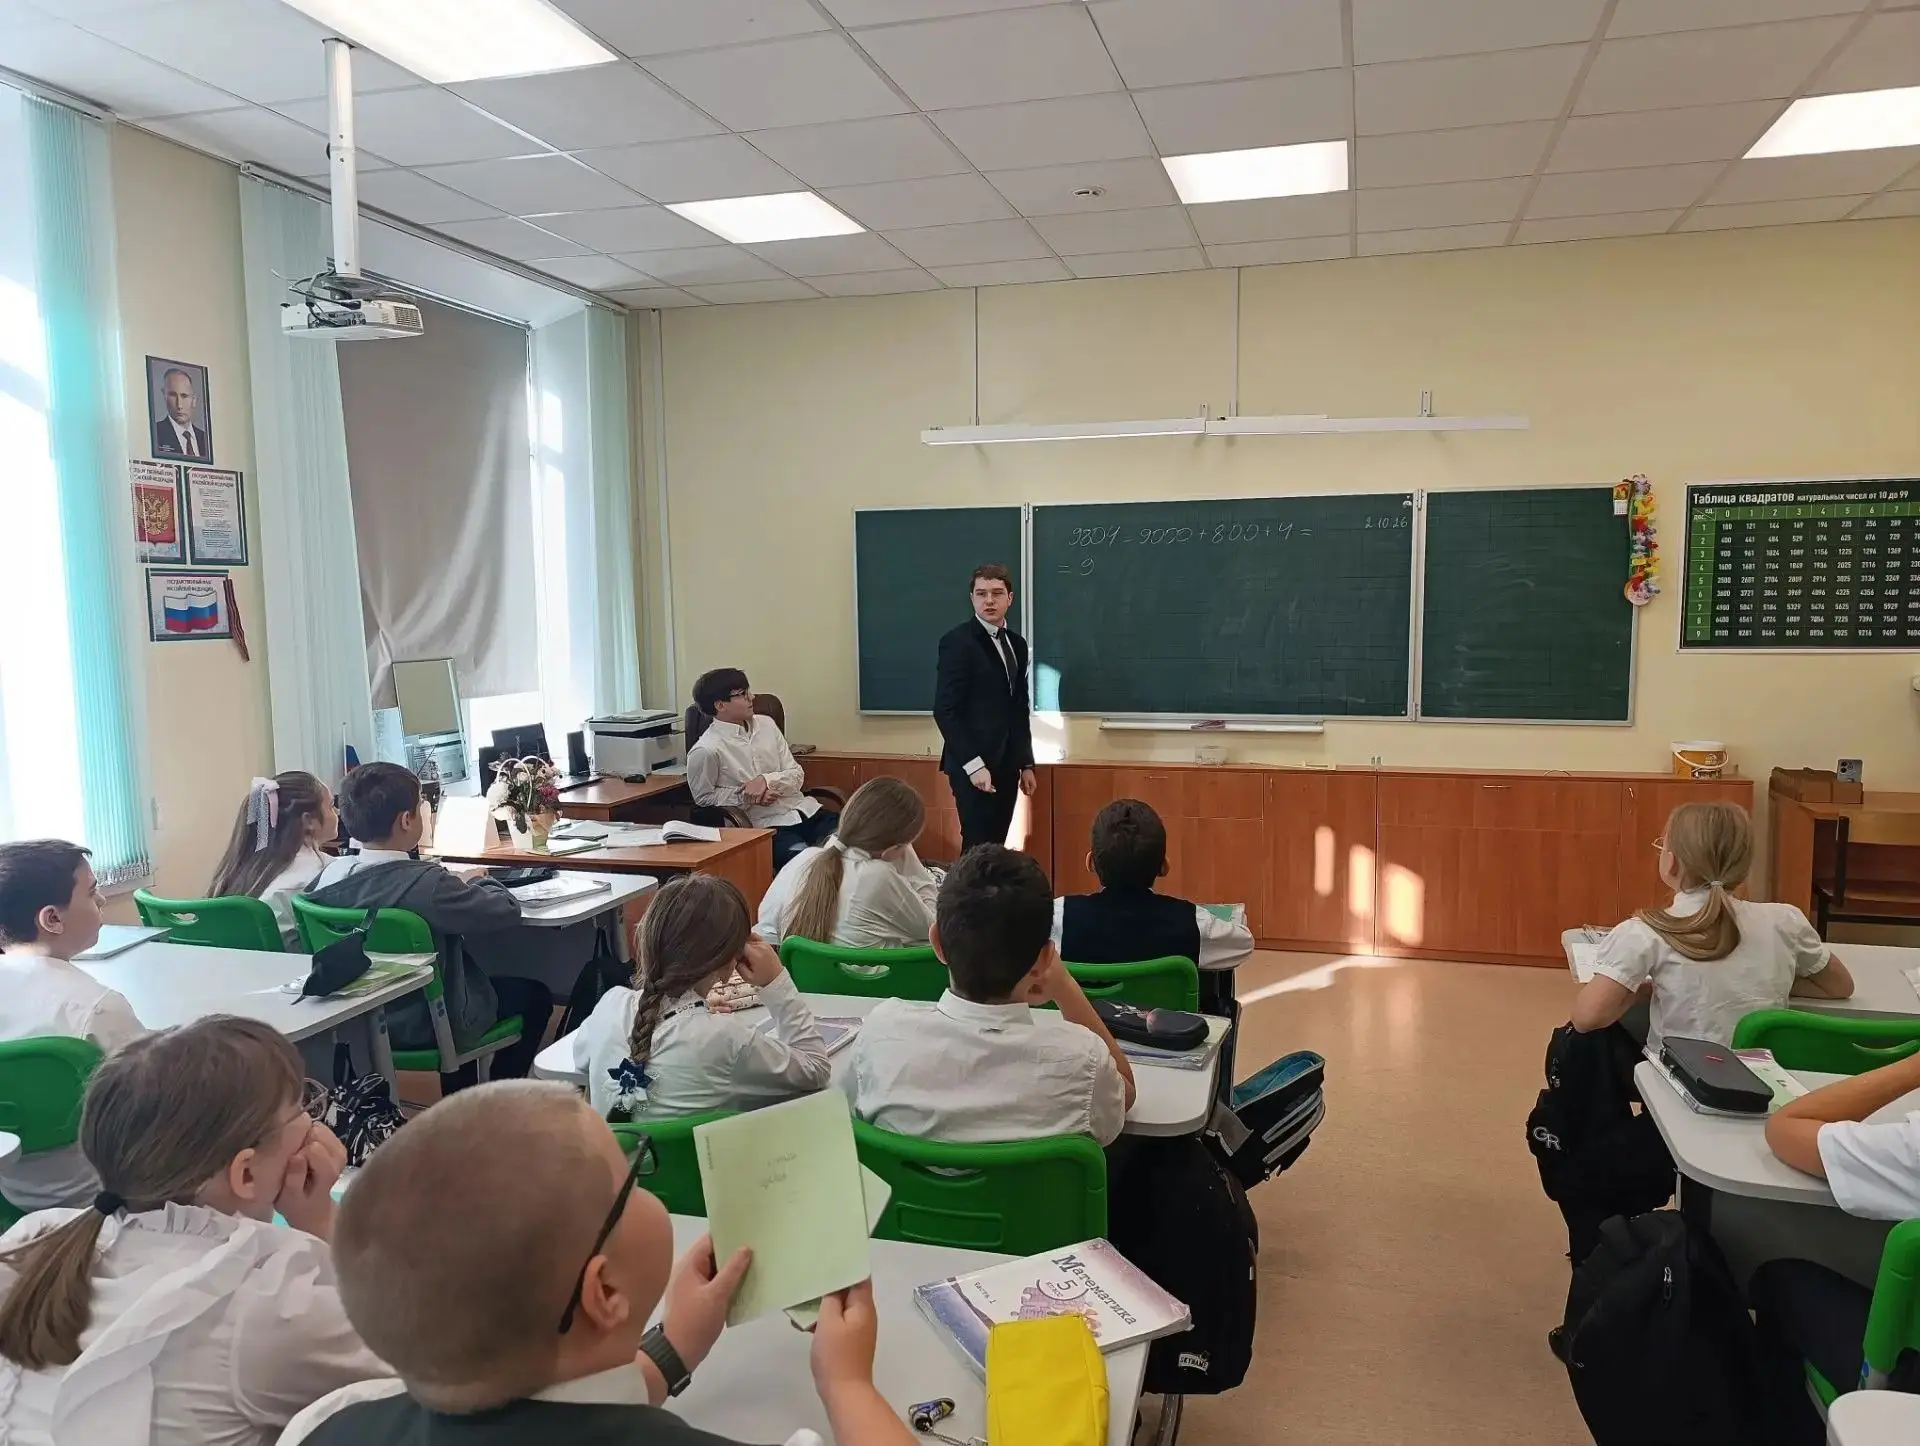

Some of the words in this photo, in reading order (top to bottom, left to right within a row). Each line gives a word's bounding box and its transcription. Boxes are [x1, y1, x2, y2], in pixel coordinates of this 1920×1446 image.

[1693, 493, 1736, 504] Таблица
[1739, 493, 1794, 504] квадратов
[1797, 494, 1844, 502] натуральных
[1533, 1126, 1561, 1150] GR
[1052, 1254, 1136, 1325] Математика
[1057, 1280, 1078, 1290] 5
